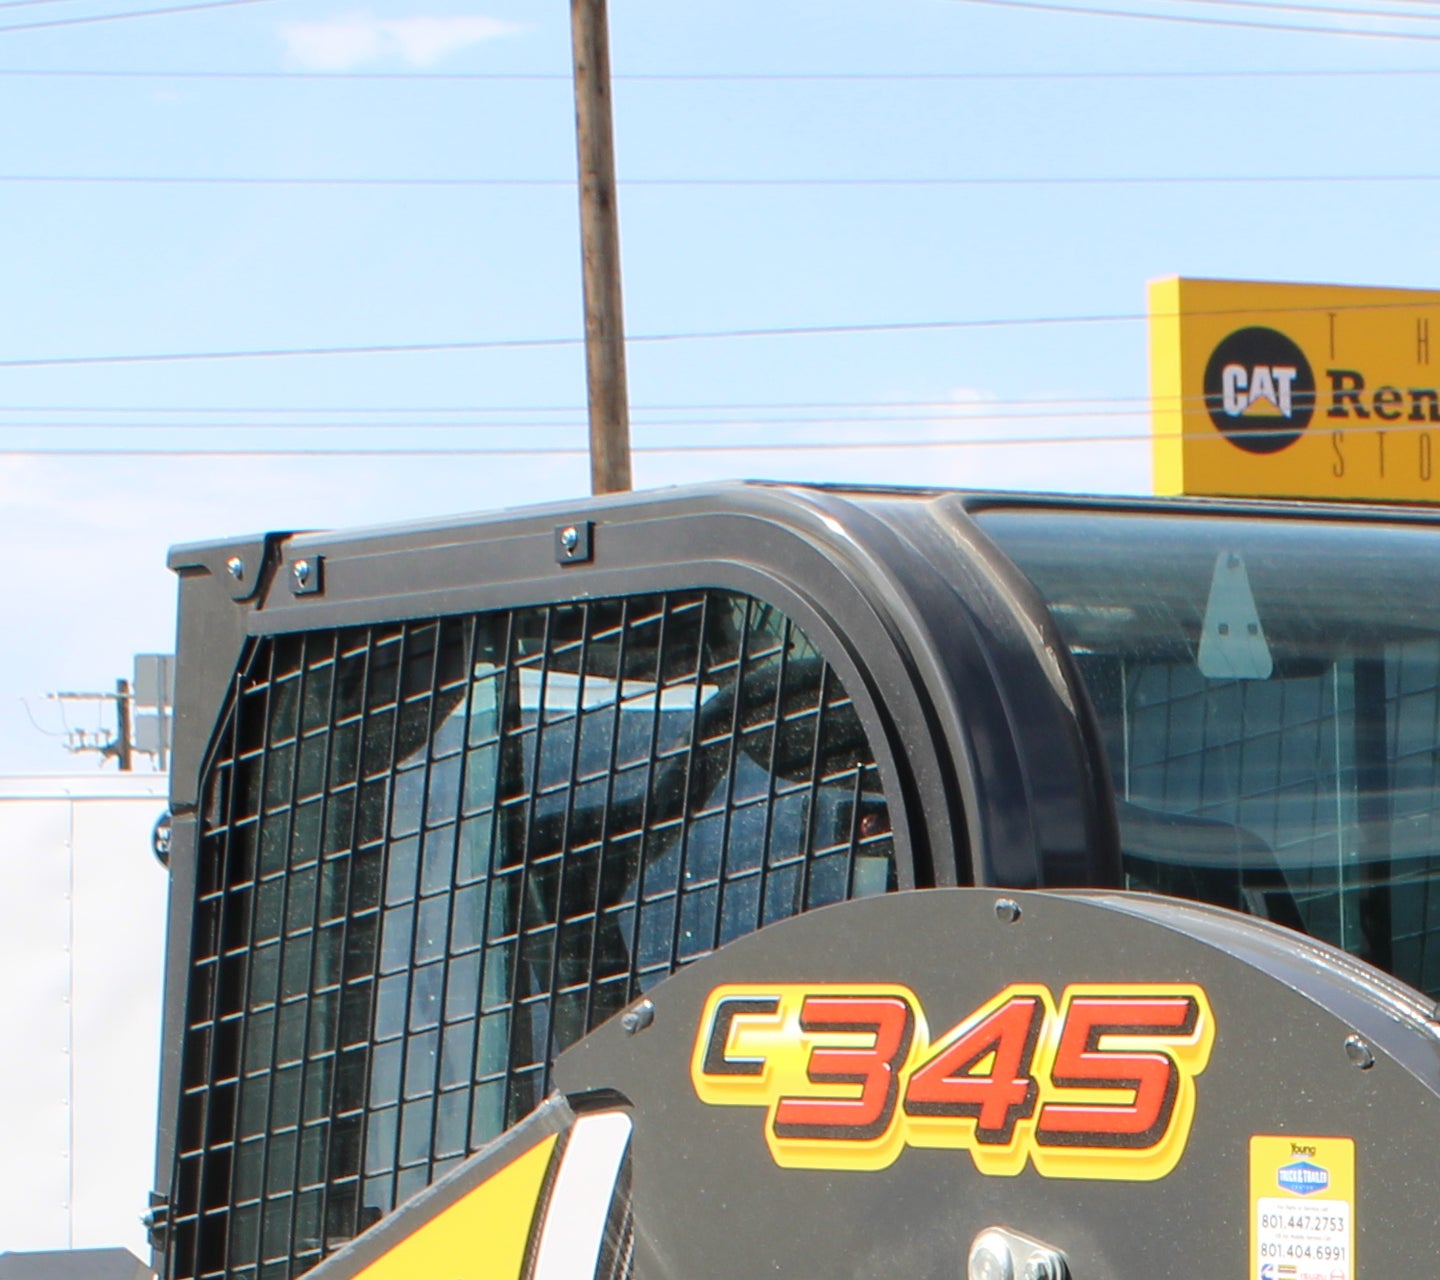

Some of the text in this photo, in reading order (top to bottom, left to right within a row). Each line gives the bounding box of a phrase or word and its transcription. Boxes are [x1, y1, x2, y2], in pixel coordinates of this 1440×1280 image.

[1222, 364, 1298, 419] CAT
[697, 988, 1208, 1165] C345
[1290, 1142, 1316, 1157] Young
[1262, 1214, 1344, 1232] 801.447.2753
[1261, 1242, 1346, 1260] 801.404.6991
